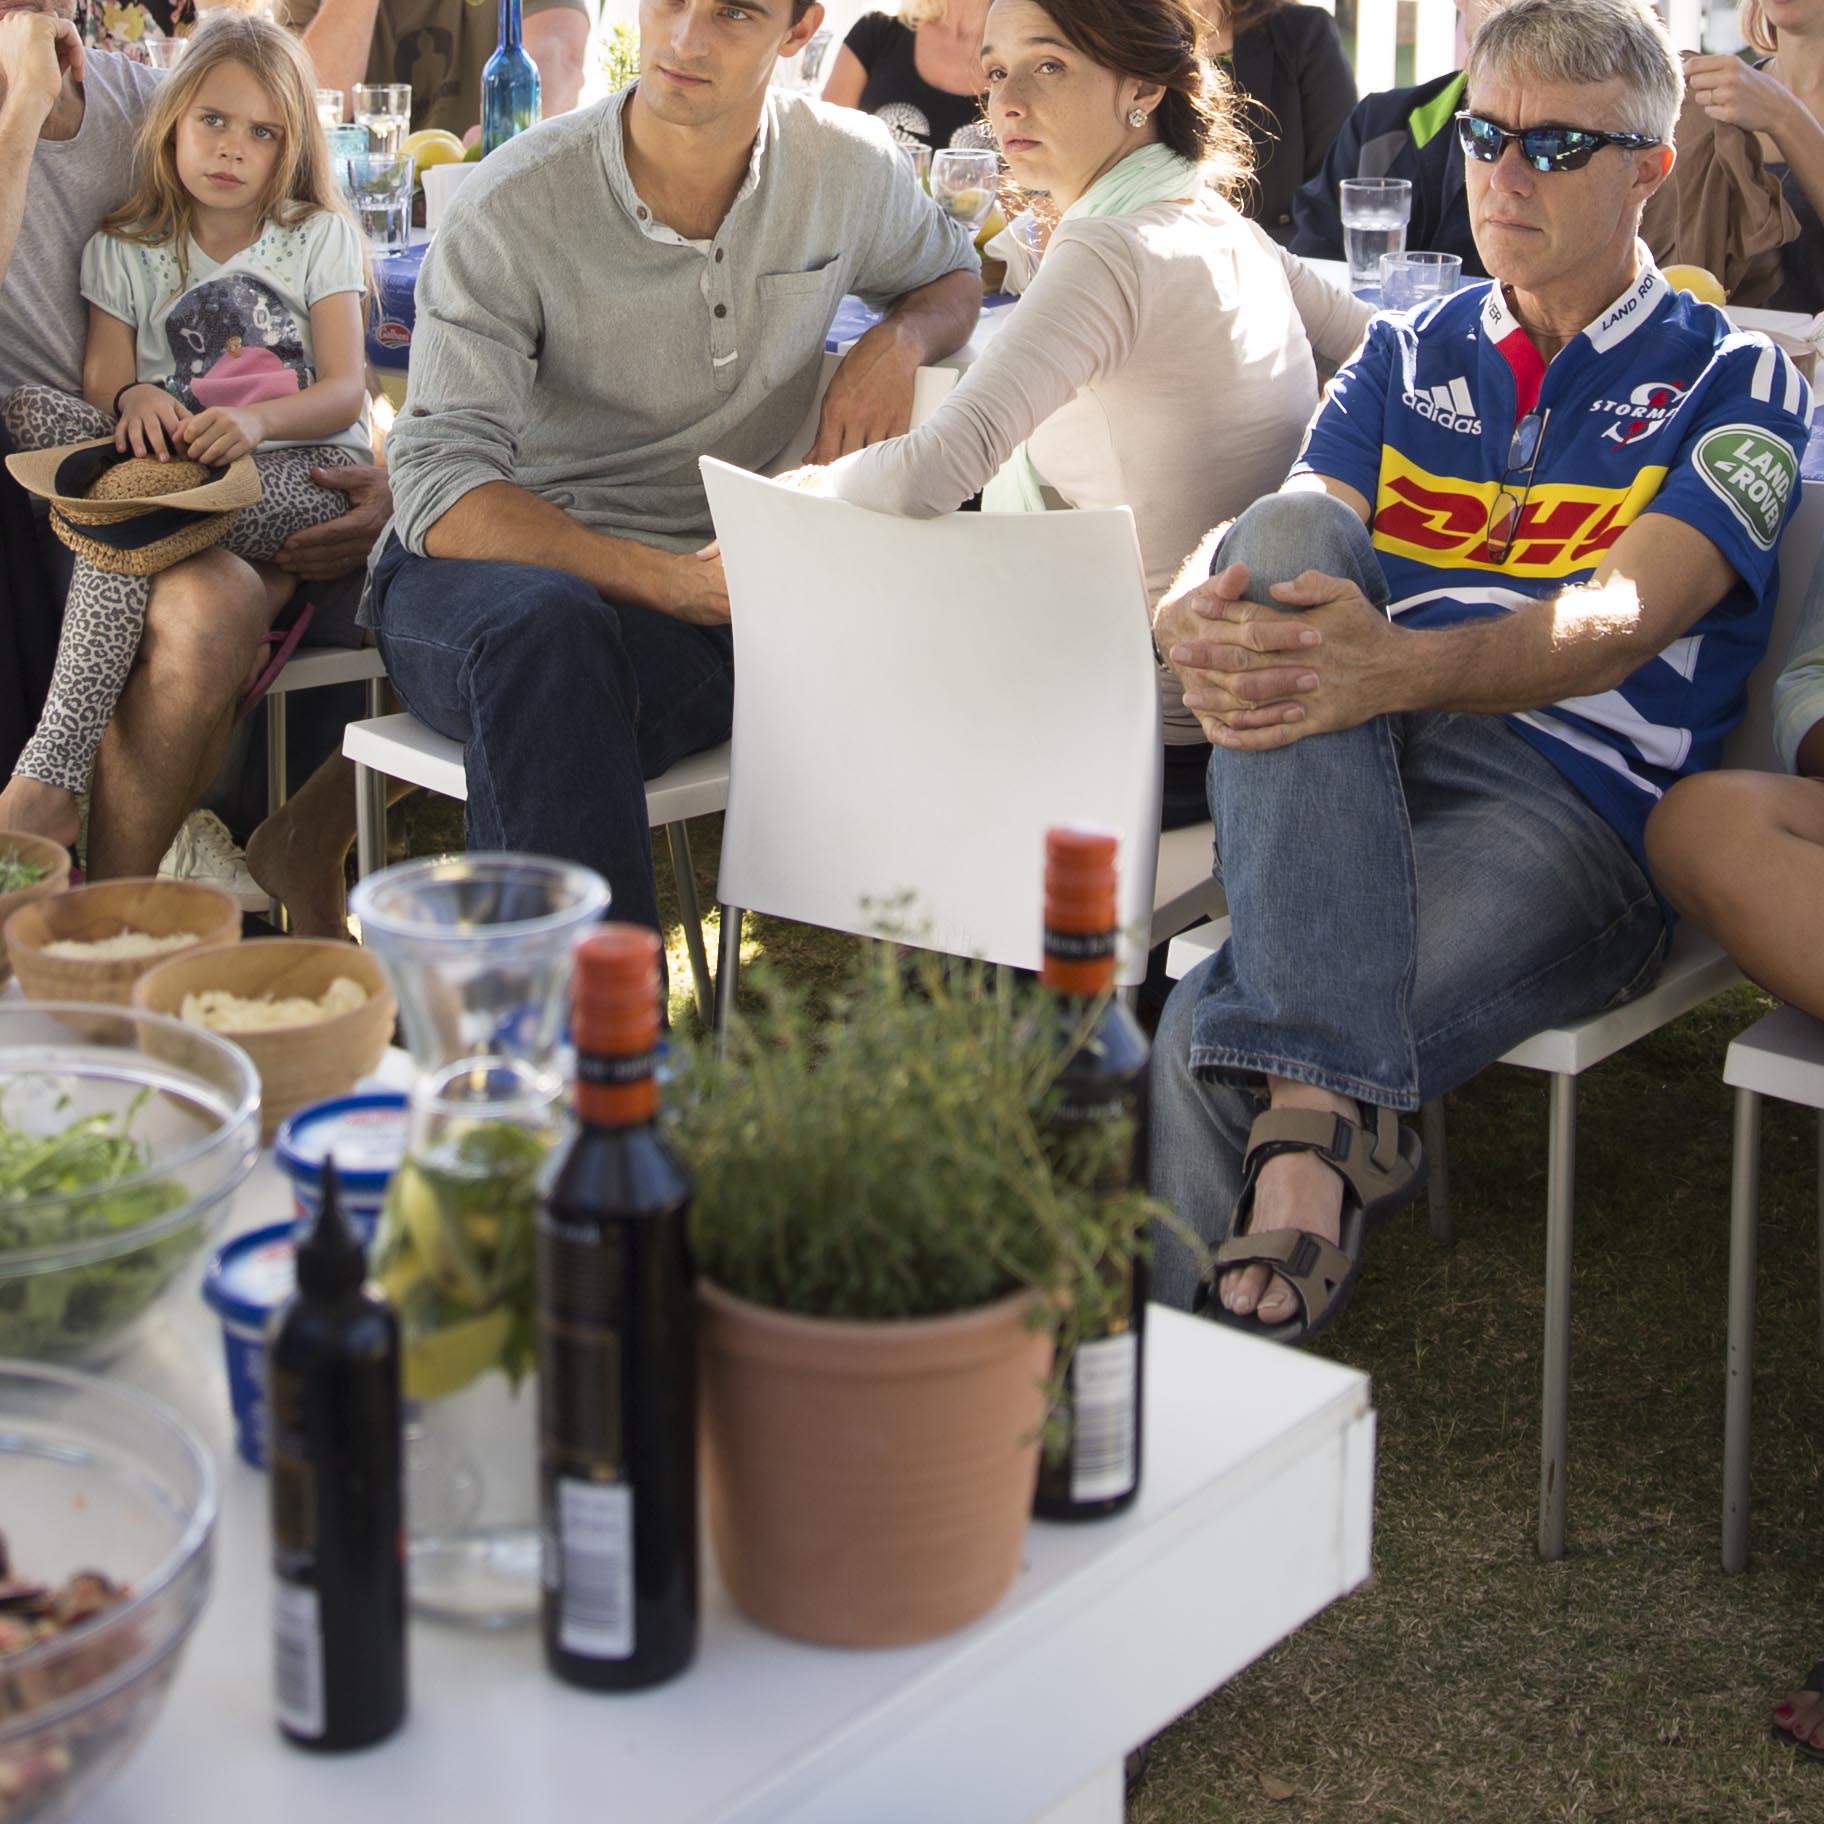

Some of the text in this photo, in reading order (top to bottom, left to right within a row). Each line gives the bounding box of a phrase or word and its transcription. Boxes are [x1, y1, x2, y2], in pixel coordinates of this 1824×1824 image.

[1602, 297, 1638, 332] LAND
[1402, 391, 1482, 435] adidas
[1732, 438, 1790, 498] LAND
[1727, 464, 1779, 534] ROVER
